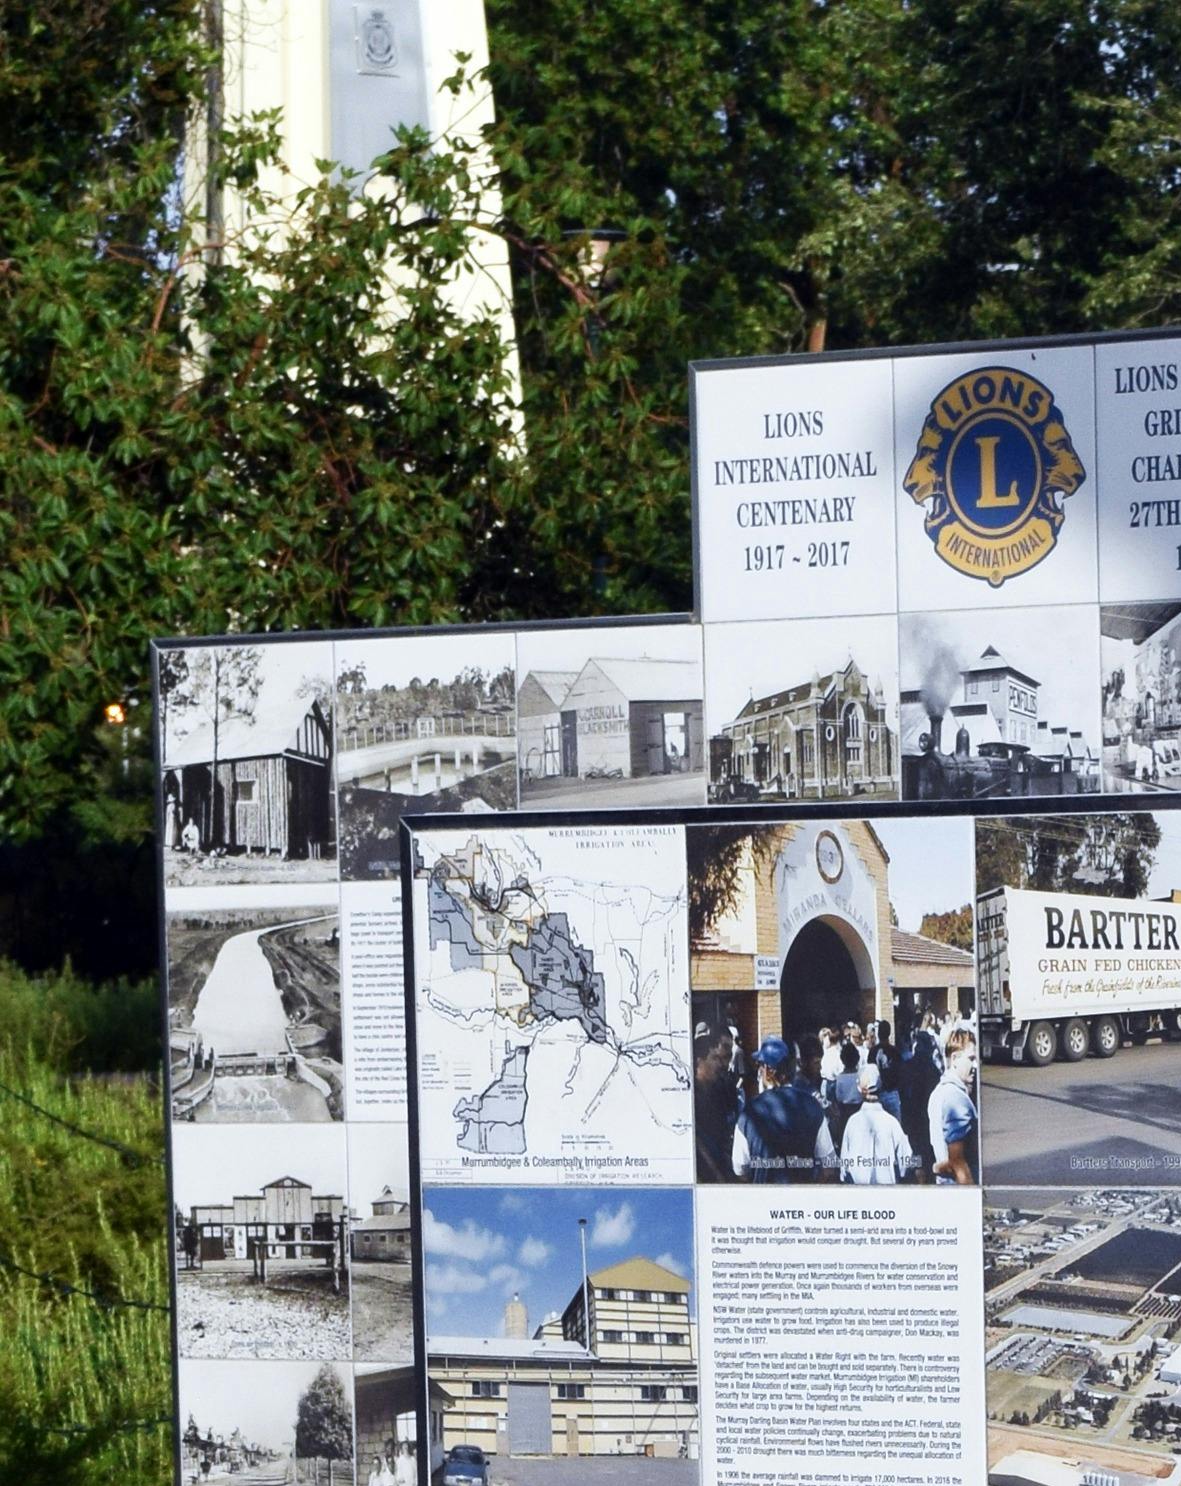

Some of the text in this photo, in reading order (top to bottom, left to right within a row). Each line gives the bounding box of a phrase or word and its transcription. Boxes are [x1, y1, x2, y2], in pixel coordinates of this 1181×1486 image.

[1114, 364, 1178, 394] LIONS
[941, 376, 1044, 423] LIONS
[764, 410, 824, 439] LIONS
[714, 451, 877, 486] INTERNATIONAL
[974, 435, 1020, 508] L
[737, 496, 856, 528] CENTENARY
[1129, 499, 1181, 528] 27TH
[745, 544, 785, 571] 1917
[807, 541, 850, 568] 2017
[945, 528, 1047, 569] INTERNATIONAL
[1044, 906, 1180, 951] BARTTER
[1038, 959, 1087, 973] GRAIN
[1094, 959, 1121, 972] FED
[462, 1156, 649, 1169] Murrumbidgee & Coleambally Irrigation Areas
[857, 1155, 891, 1168] Festival
[1110, 1156, 1154, 1171] Transport
[770, 1210, 804, 1220] WATER
[814, 1210, 835, 1220] OUR
[838, 1210, 858, 1220] LIFE
[861, 1210, 896, 1220] BLOOD
[711, 1226, 728, 1234] Water
[737, 1226, 746, 1234] the
[805, 1226, 822, 1234] Water
[824, 1226, 843, 1235] turned
[896, 1227, 907, 1235] into
[914, 1227, 944, 1235] food-bowl
[946, 1227, 957, 1235] and
[752, 1473, 775, 1481] average
[815, 1473, 841, 1482] dammed
[851, 1474, 872, 1484] irrigate
[875, 1475, 895, 1484] 17,000
[897, 1475, 924, 1484] hectares.
[952, 1476, 962, 1484] the
